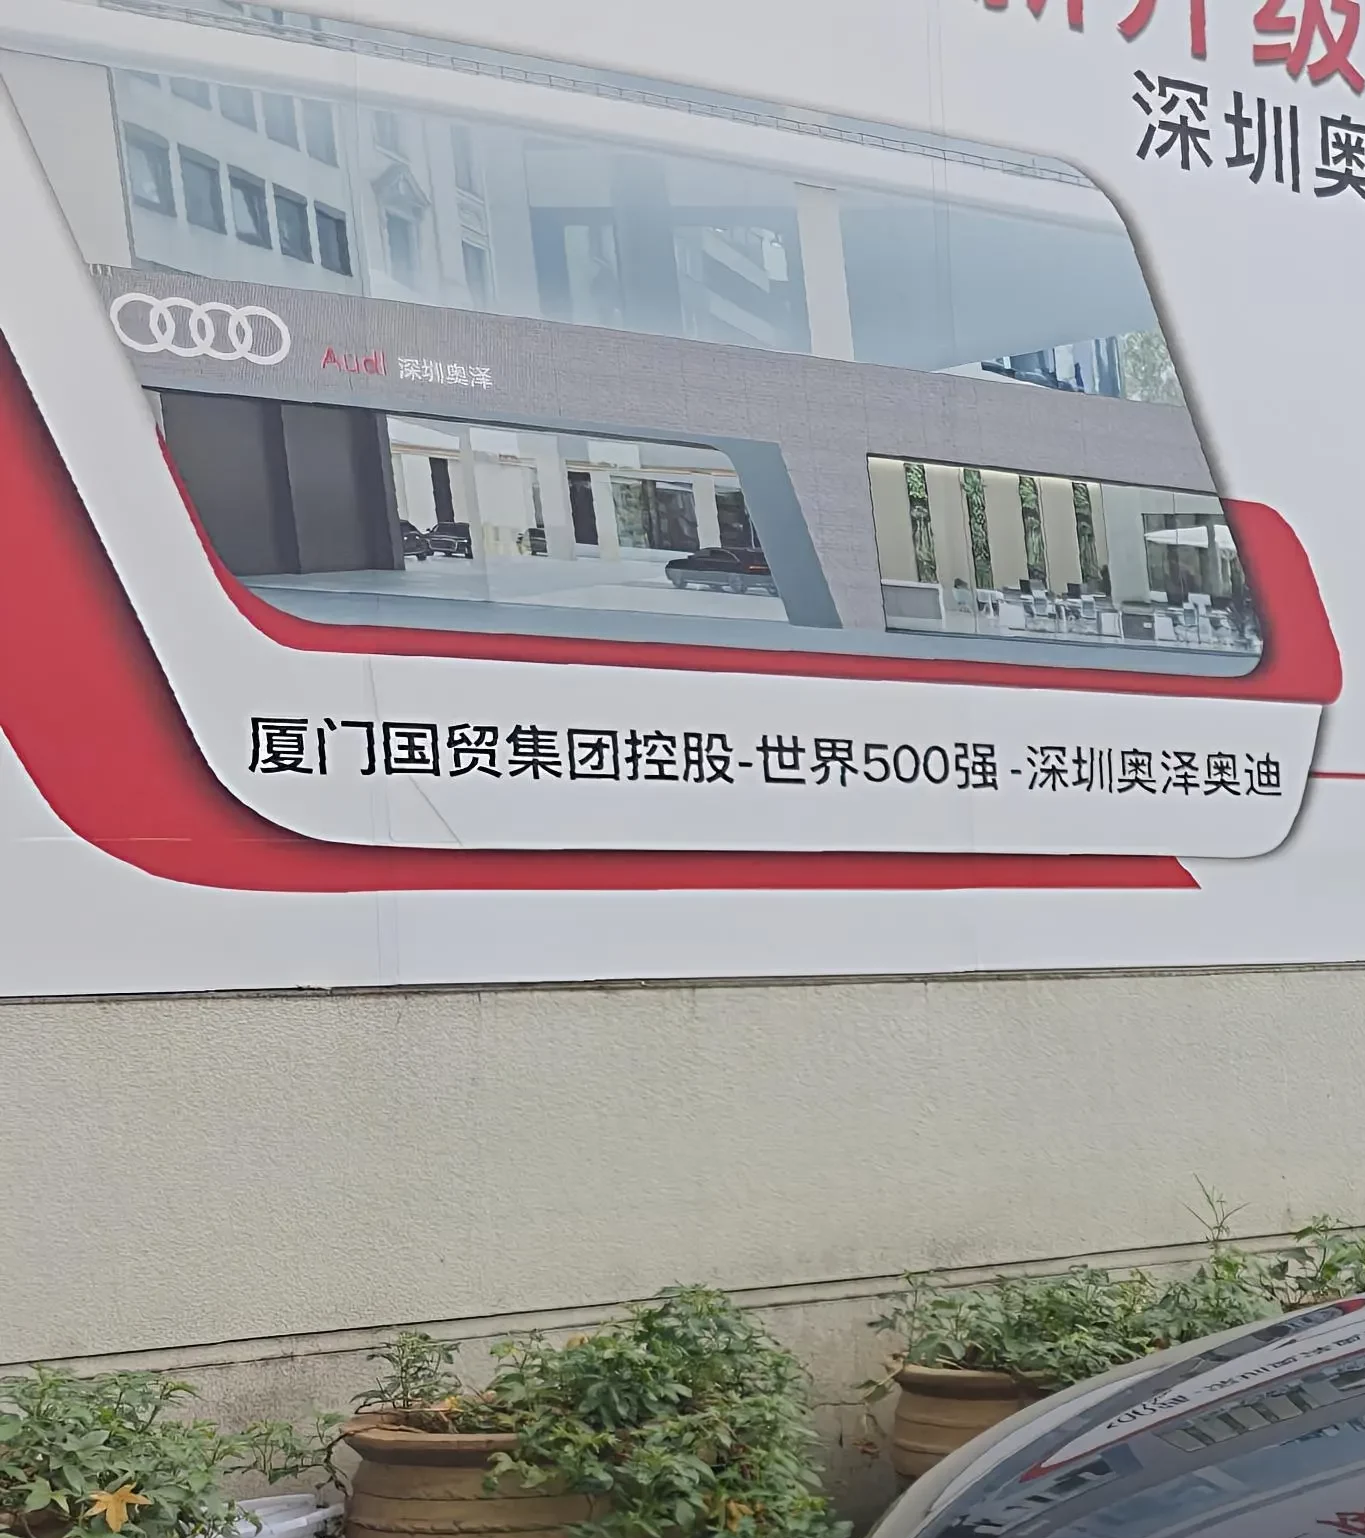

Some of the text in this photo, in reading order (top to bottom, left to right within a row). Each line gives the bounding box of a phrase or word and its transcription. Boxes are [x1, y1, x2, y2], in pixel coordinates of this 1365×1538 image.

[321, 347, 493, 389] Audi 深圳奥泽
